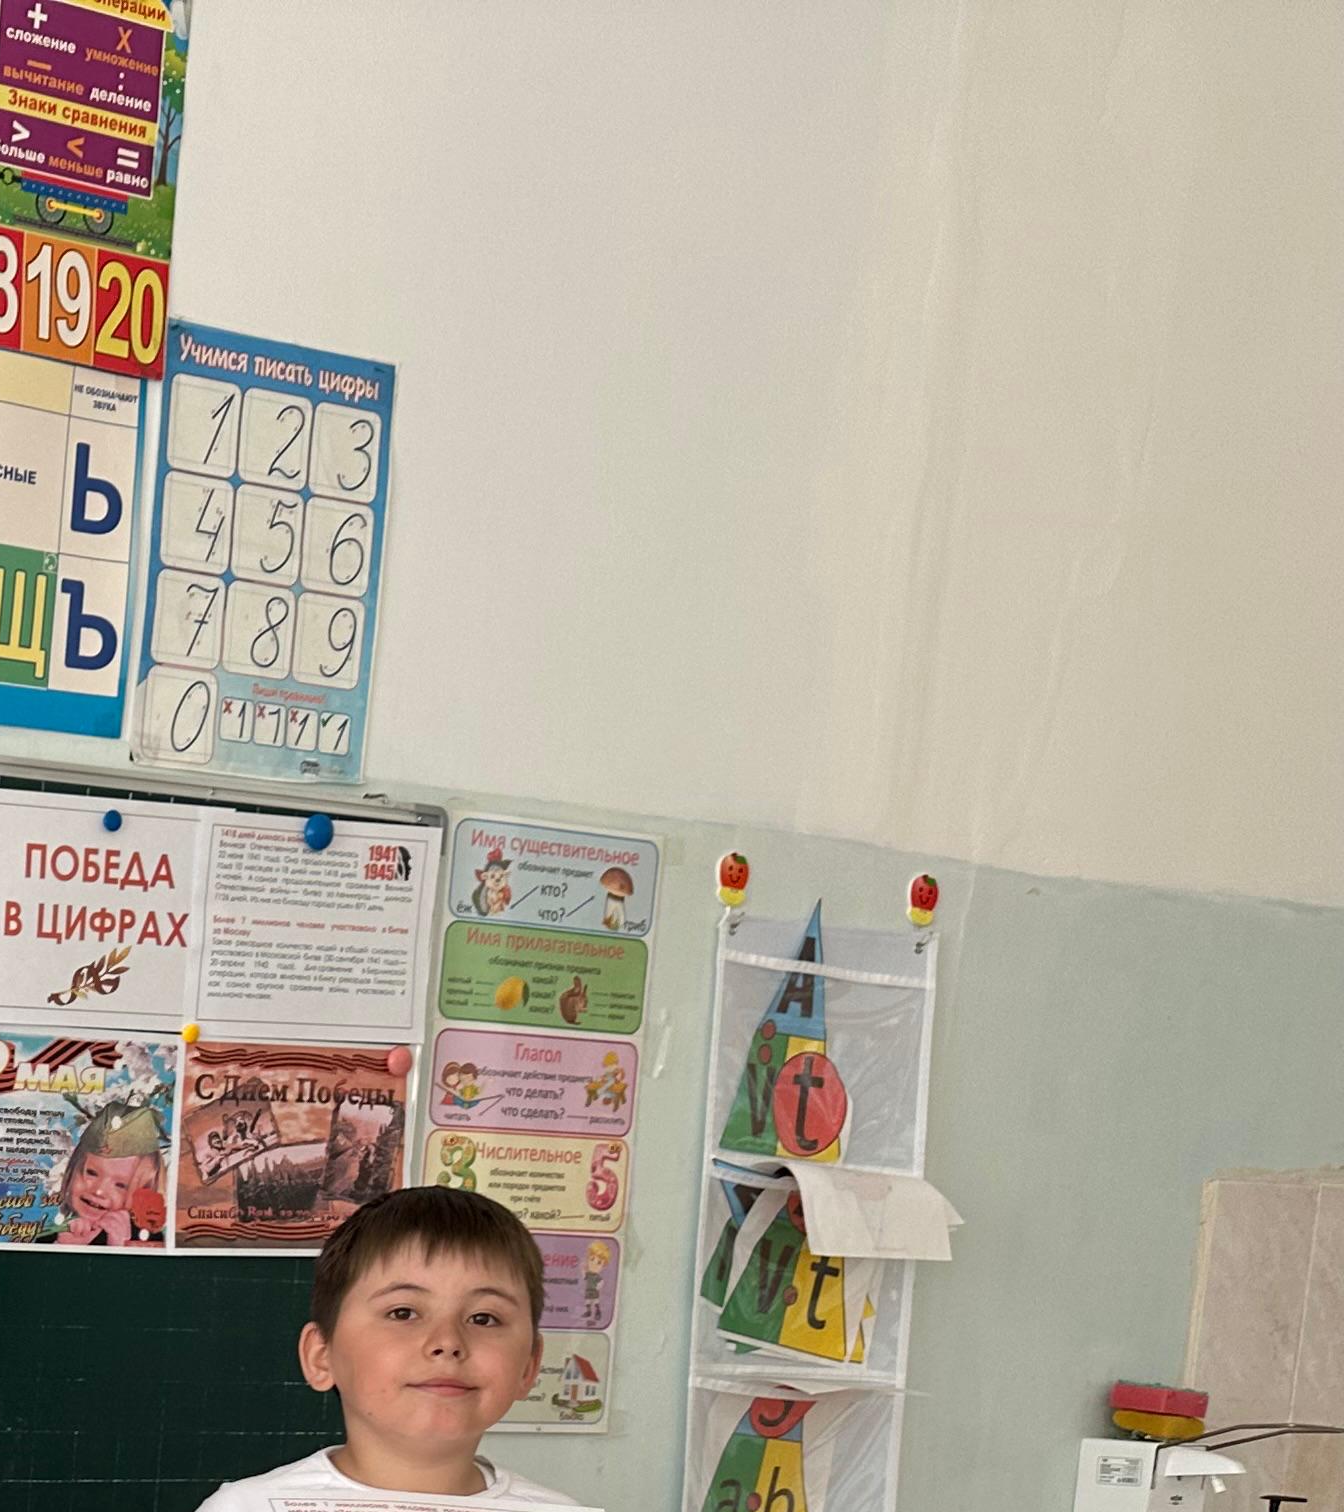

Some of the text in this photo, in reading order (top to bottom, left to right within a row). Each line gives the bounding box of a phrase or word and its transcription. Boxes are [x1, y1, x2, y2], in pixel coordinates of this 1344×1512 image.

[5, 26, 77, 55] сложение
[84, 47, 159, 77] умножение
[3, 64, 85, 96] вычитание
[7, 88, 147, 138] Знаки сравнения
[89, 86, 152, 112] деление
[48, 155, 104, 179] меньше
[105, 168, 150, 190] равно
[25, 241, 92, 348] 19
[94, 259, 165, 366] 20
[180, 336, 379, 400] Учимся писать цифры
[74, 384, 138, 403] НЕ ОБОЗНАЧАЮТ
[93, 400, 116, 411] ЗВУКА
[368, 845, 398, 862] 1941
[471, 830, 640, 866] Имя существительное
[24, 843, 175, 892] ПОБЕДА
[363, 863, 393, 881] 1945
[540, 883, 568, 898] кто?
[3, 901, 190, 948] В ЦИФРАХ
[538, 907, 566, 922] что?
[466, 928, 625, 960] Имя прилагательное
[514, 1043, 562, 1063] Глагол
[14, 1062, 107, 1094] МАЯ
[194, 1074, 214, 1099] С
[295, 1074, 395, 1110] Победы
[505, 1088, 565, 1100] что делать?
[501, 1107, 566, 1120] что сделать?
[475, 1141, 583, 1164] Числительное
